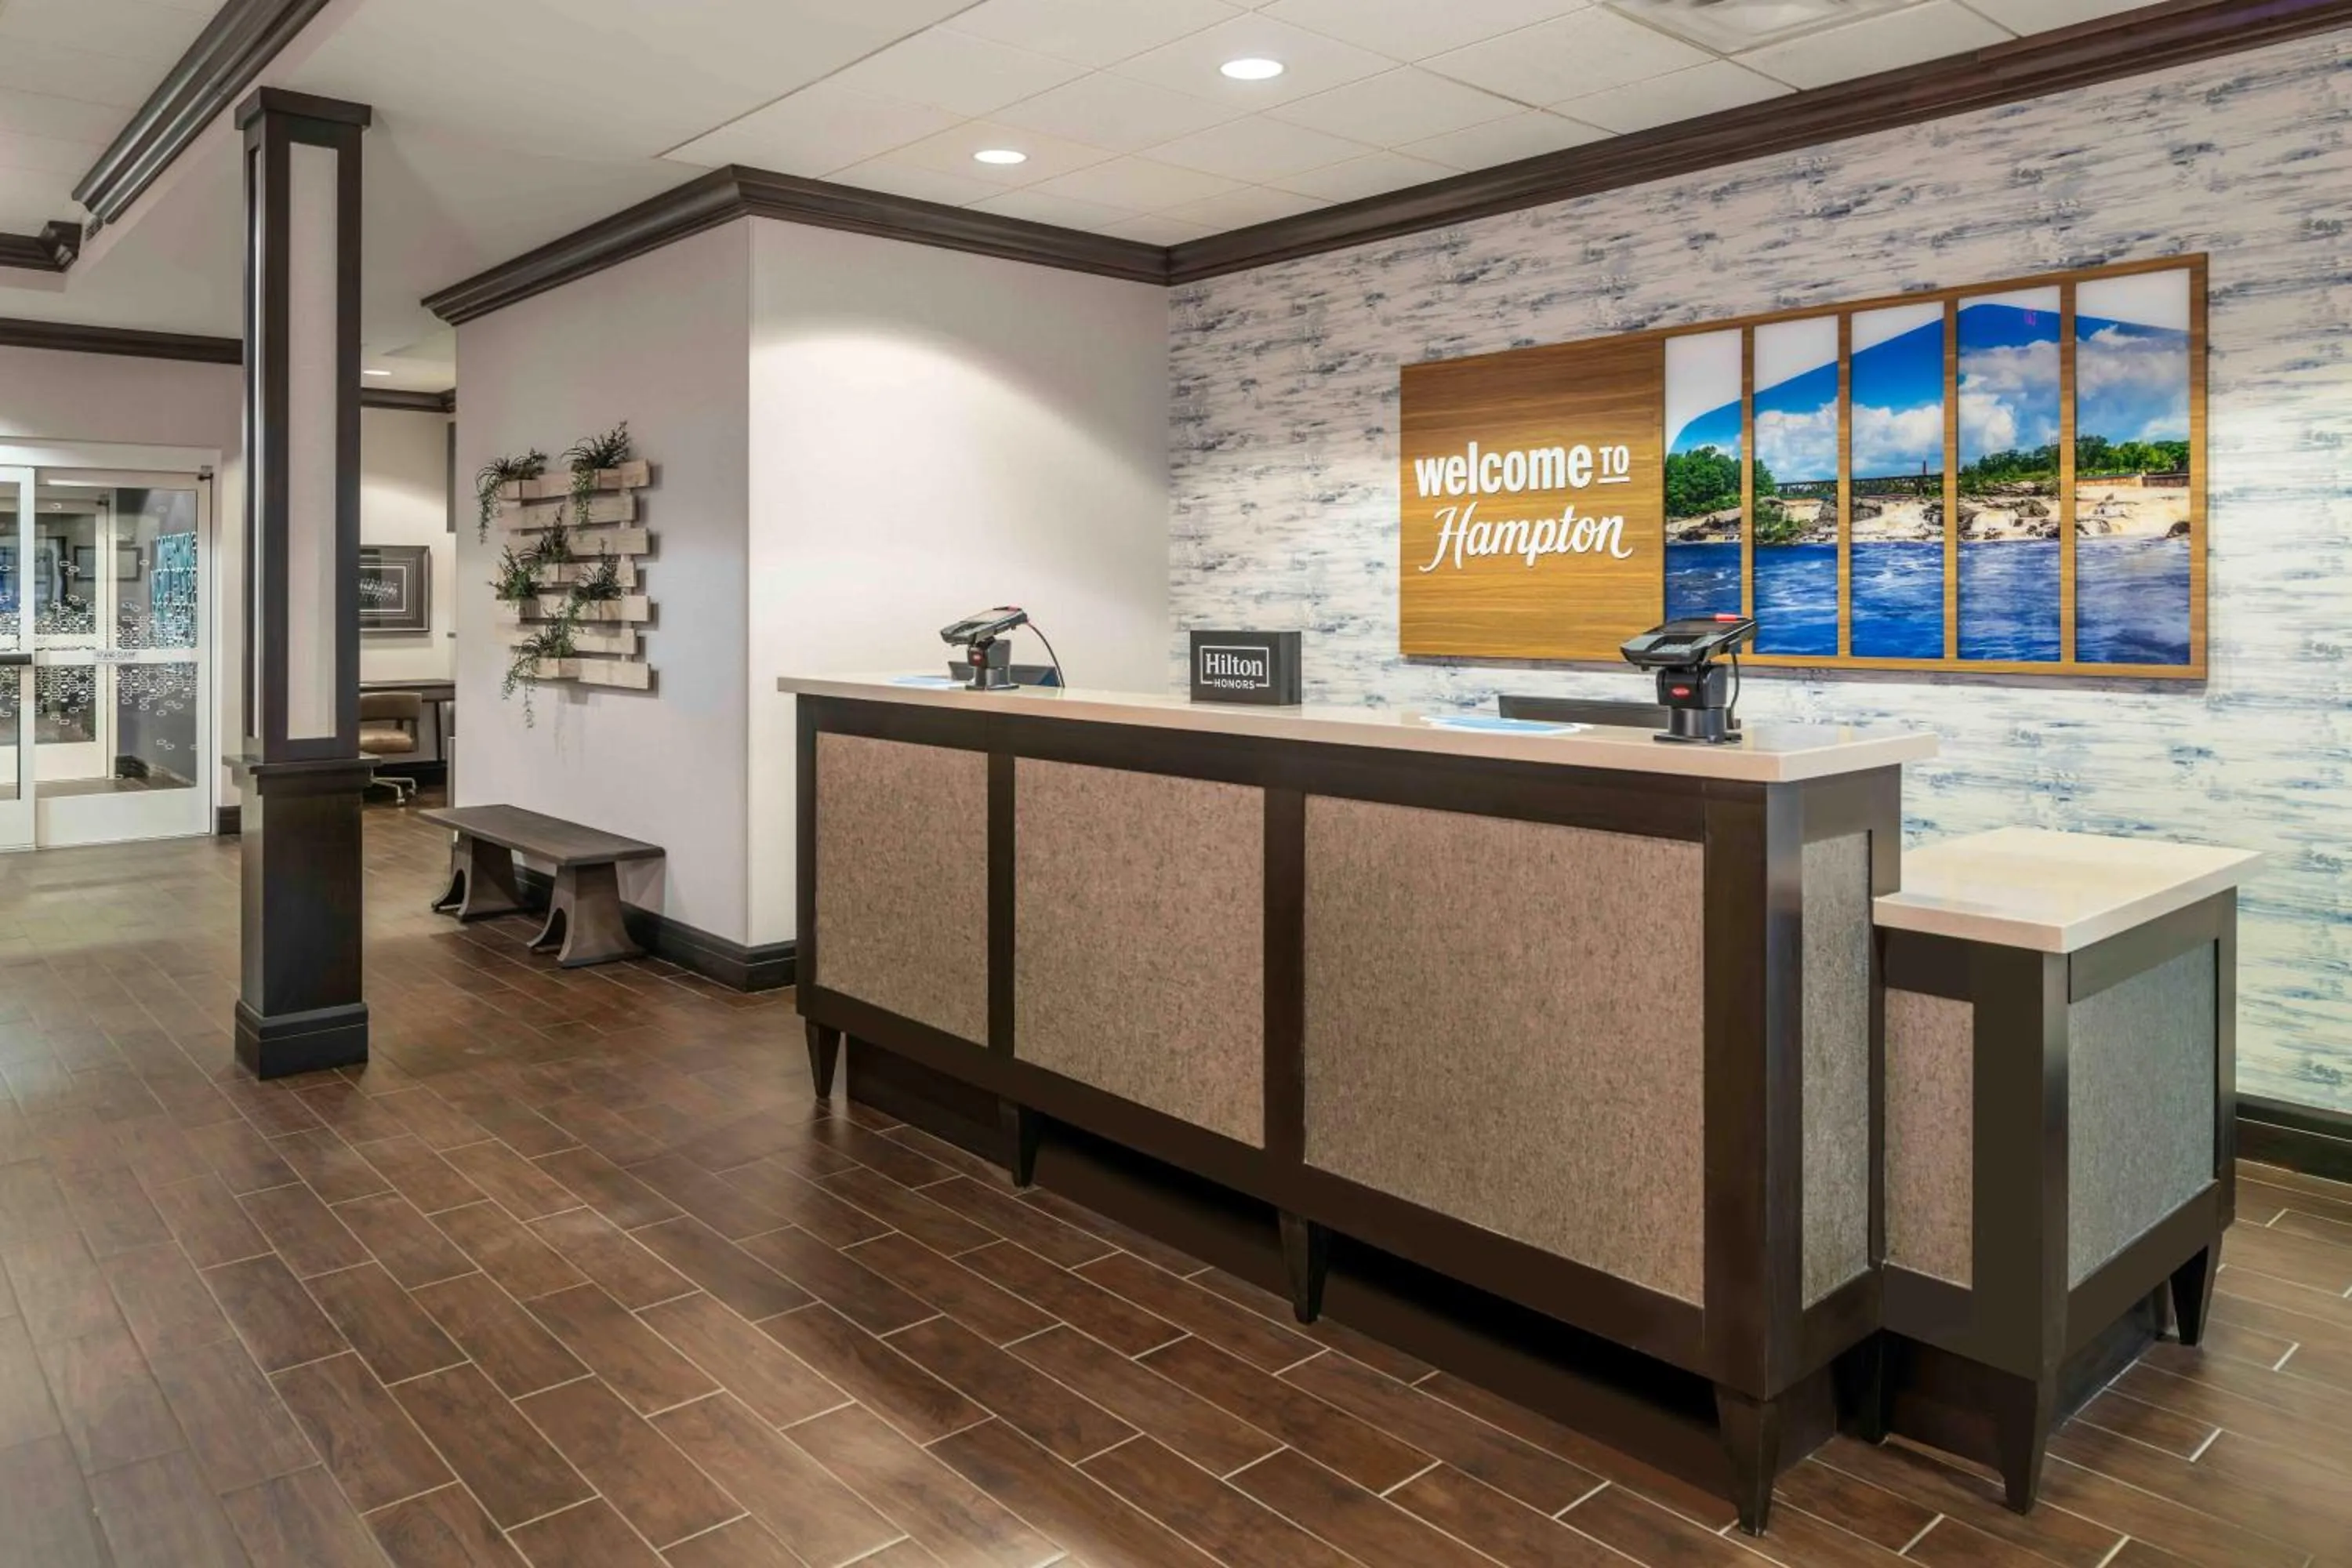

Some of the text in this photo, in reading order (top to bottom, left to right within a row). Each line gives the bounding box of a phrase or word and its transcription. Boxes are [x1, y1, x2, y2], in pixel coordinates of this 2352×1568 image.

[1415, 441, 1630, 496] welcome TO
[1418, 501, 1632, 572] Hampton
[1205, 653, 1263, 676] Hilton
[1214, 678, 1255, 688] HONORS
